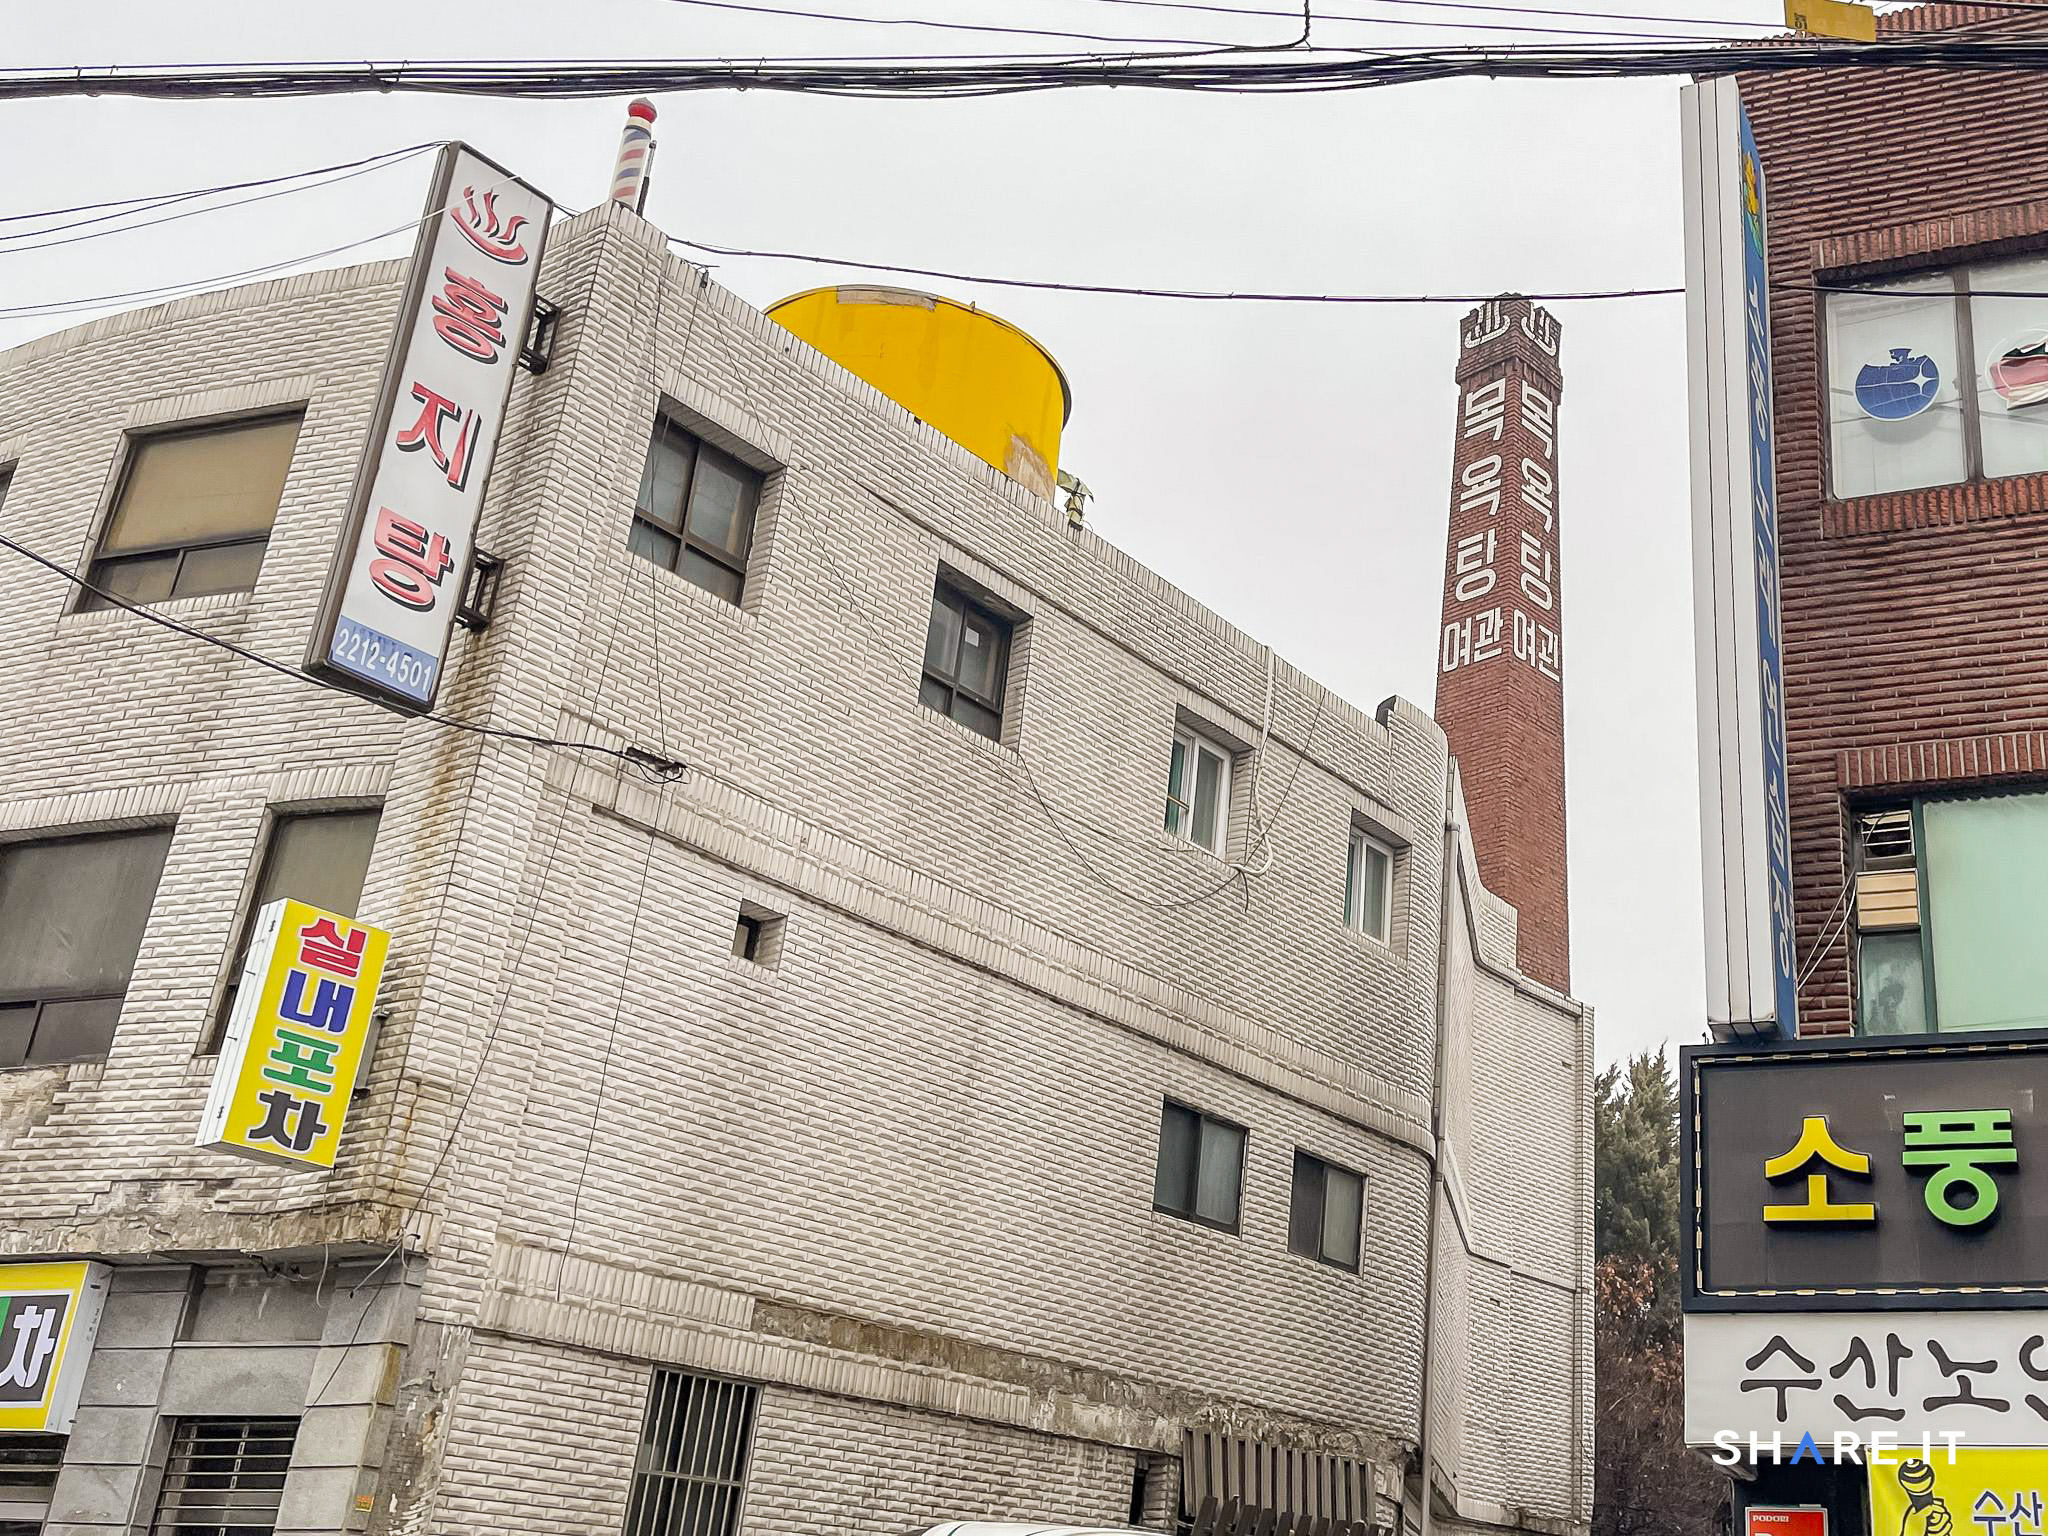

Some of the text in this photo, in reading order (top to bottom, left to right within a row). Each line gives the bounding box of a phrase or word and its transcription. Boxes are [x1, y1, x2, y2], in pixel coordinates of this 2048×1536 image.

[369, 265, 508, 614] 홍지탕
[1455, 377, 1507, 602] 목욕탕
[1520, 380, 1554, 611] 목욕탕
[335, 627, 432, 693] 2212-4501
[1442, 606, 1504, 673] 여관
[1512, 608, 1561, 683] 여관
[248, 916, 368, 1153] 실내포차
[1762, 1108, 2019, 1227] 소풍
